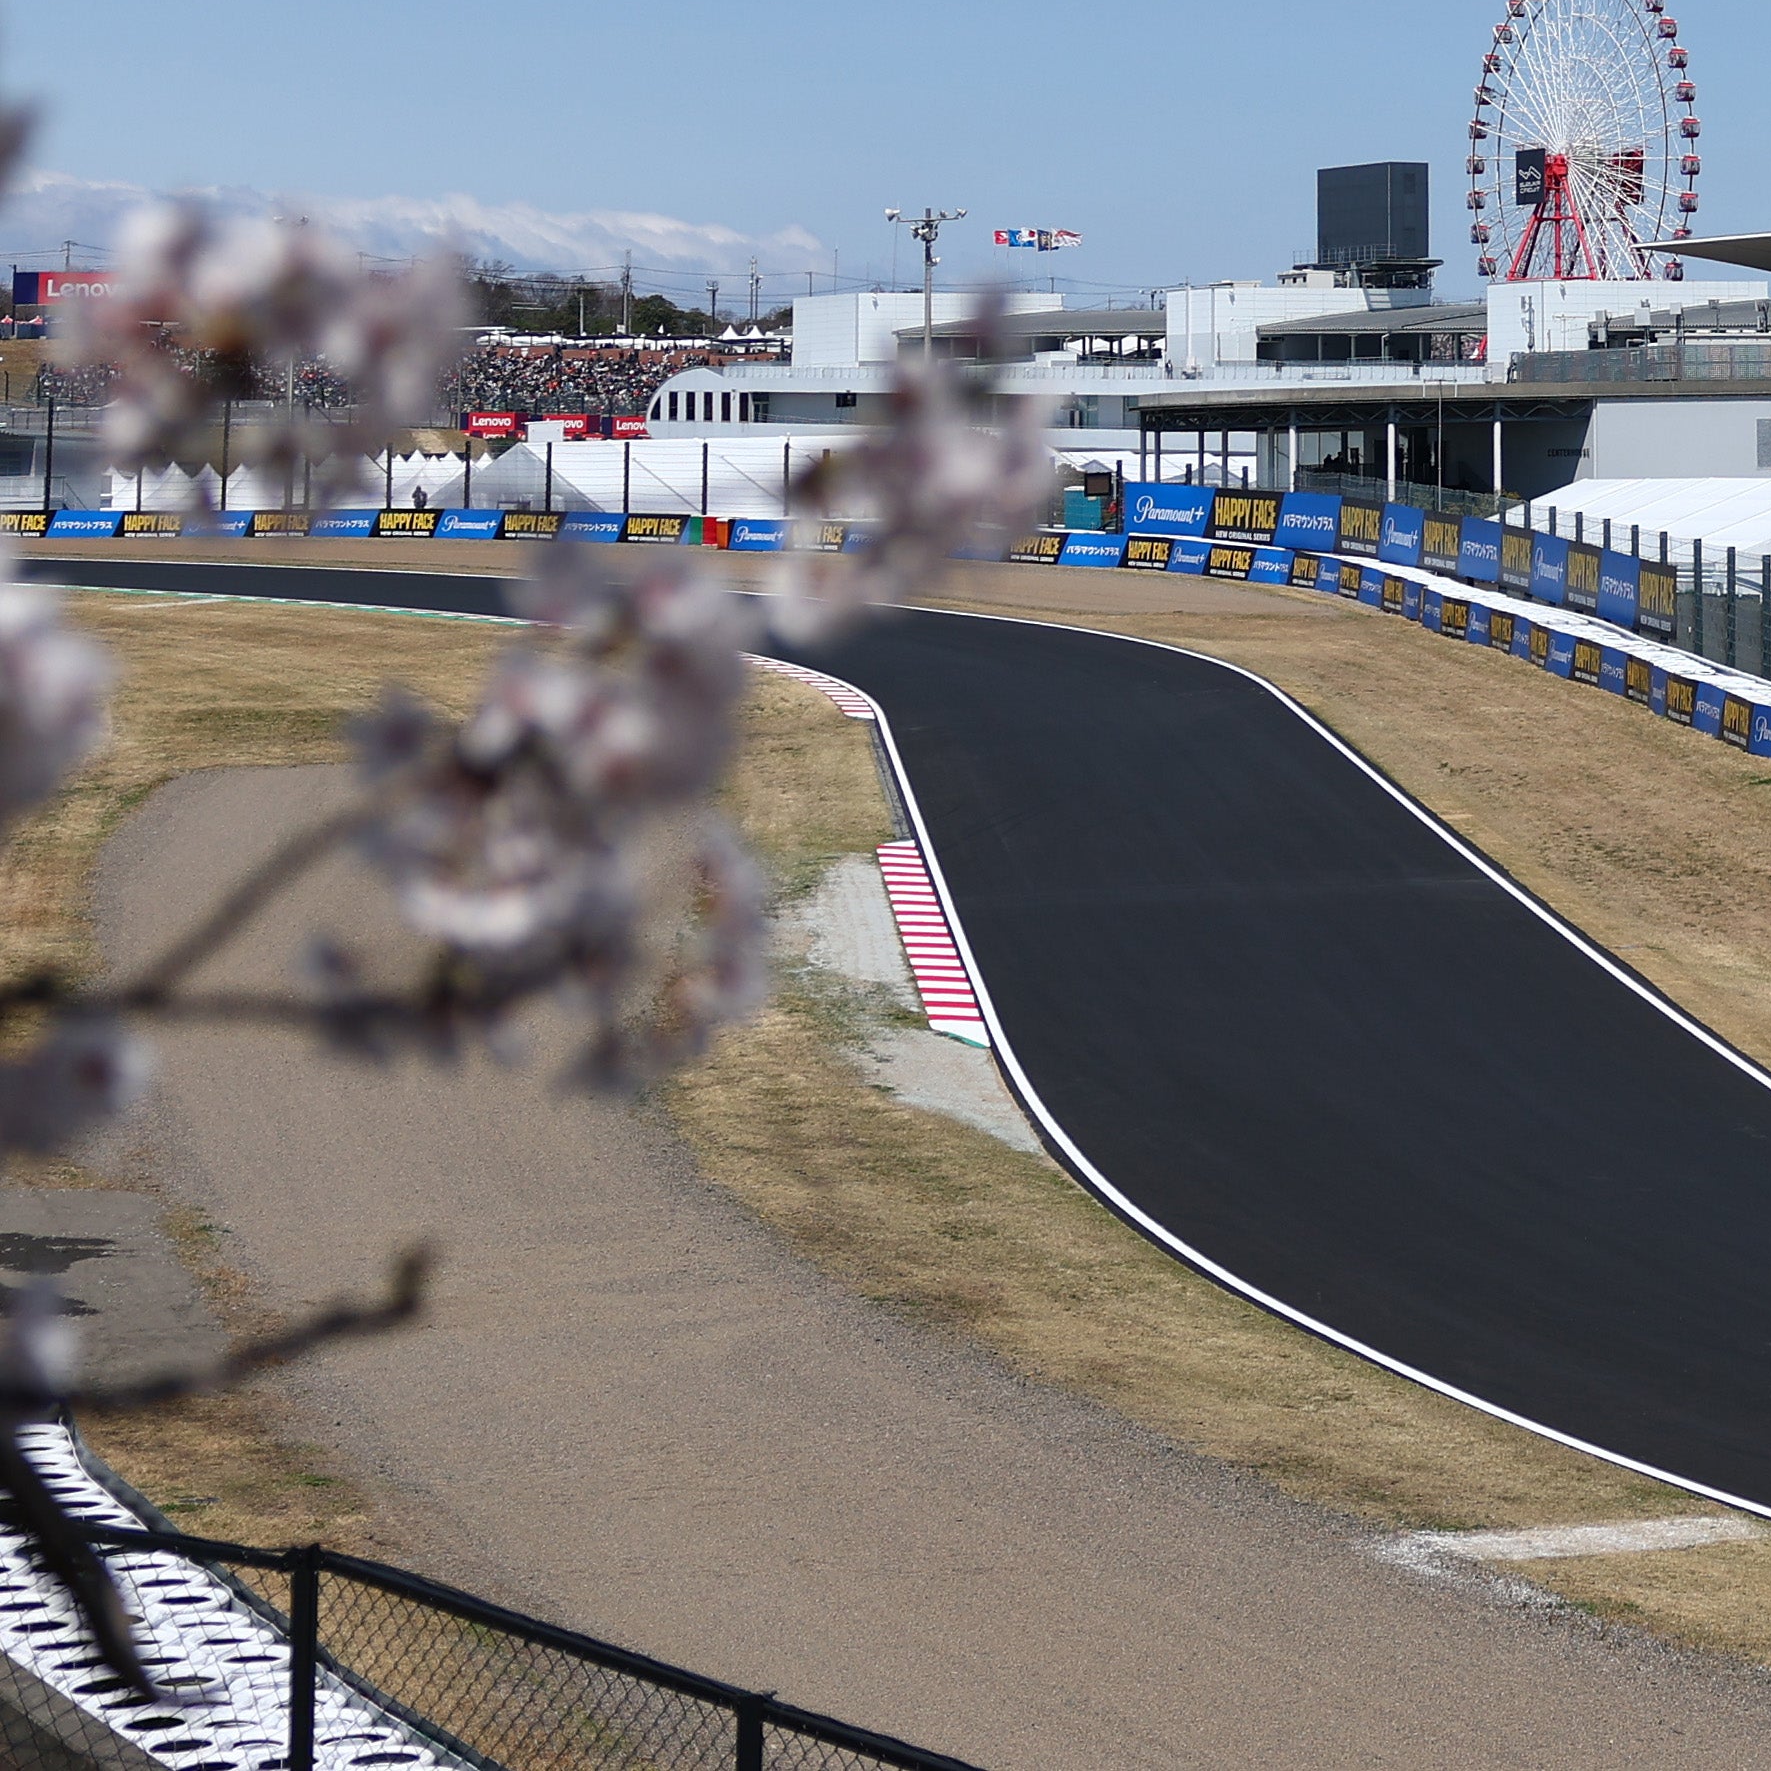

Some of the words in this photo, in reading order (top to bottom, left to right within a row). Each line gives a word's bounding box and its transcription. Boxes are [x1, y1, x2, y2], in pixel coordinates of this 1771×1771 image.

[472, 416, 511, 427] Lenovo
[1134, 495, 1205, 524] Paramount+
[1215, 496, 1252, 528] HAPPY
[1253, 499, 1277, 530] FACE
[0, 515, 20, 531] PPY
[21, 515, 45, 531] FACE
[124, 515, 157, 531] HAPPY
[158, 515, 181, 531] FACE
[380, 513, 412, 530] HAPPY
[413, 514, 436, 530] FACE
[441, 516, 497, 532] Paramount+
[505, 515, 537, 532] HAPPY
[537, 516, 558, 532] FACE
[627, 517, 659, 534] HAPPY
[660, 518, 681, 535] FACE
[1282, 513, 1334, 532] パラマウントプラス
[1341, 505, 1364, 539] HAPPY
[1365, 509, 1380, 541] FACE
[823, 527, 844, 543] FACE
[1215, 530, 1227, 539] NEW
[1228, 531, 1251, 540] ORIGINAL
[1253, 533, 1270, 542] SERIES
[1424, 519, 1444, 555] HAPPY
[1445, 523, 1459, 557] FACE
[1128, 540, 1152, 560] HAPPY
[1153, 542, 1169, 561] FACE
[1210, 548, 1232, 569] HAPPY
[1232, 550, 1252, 571] FACE
